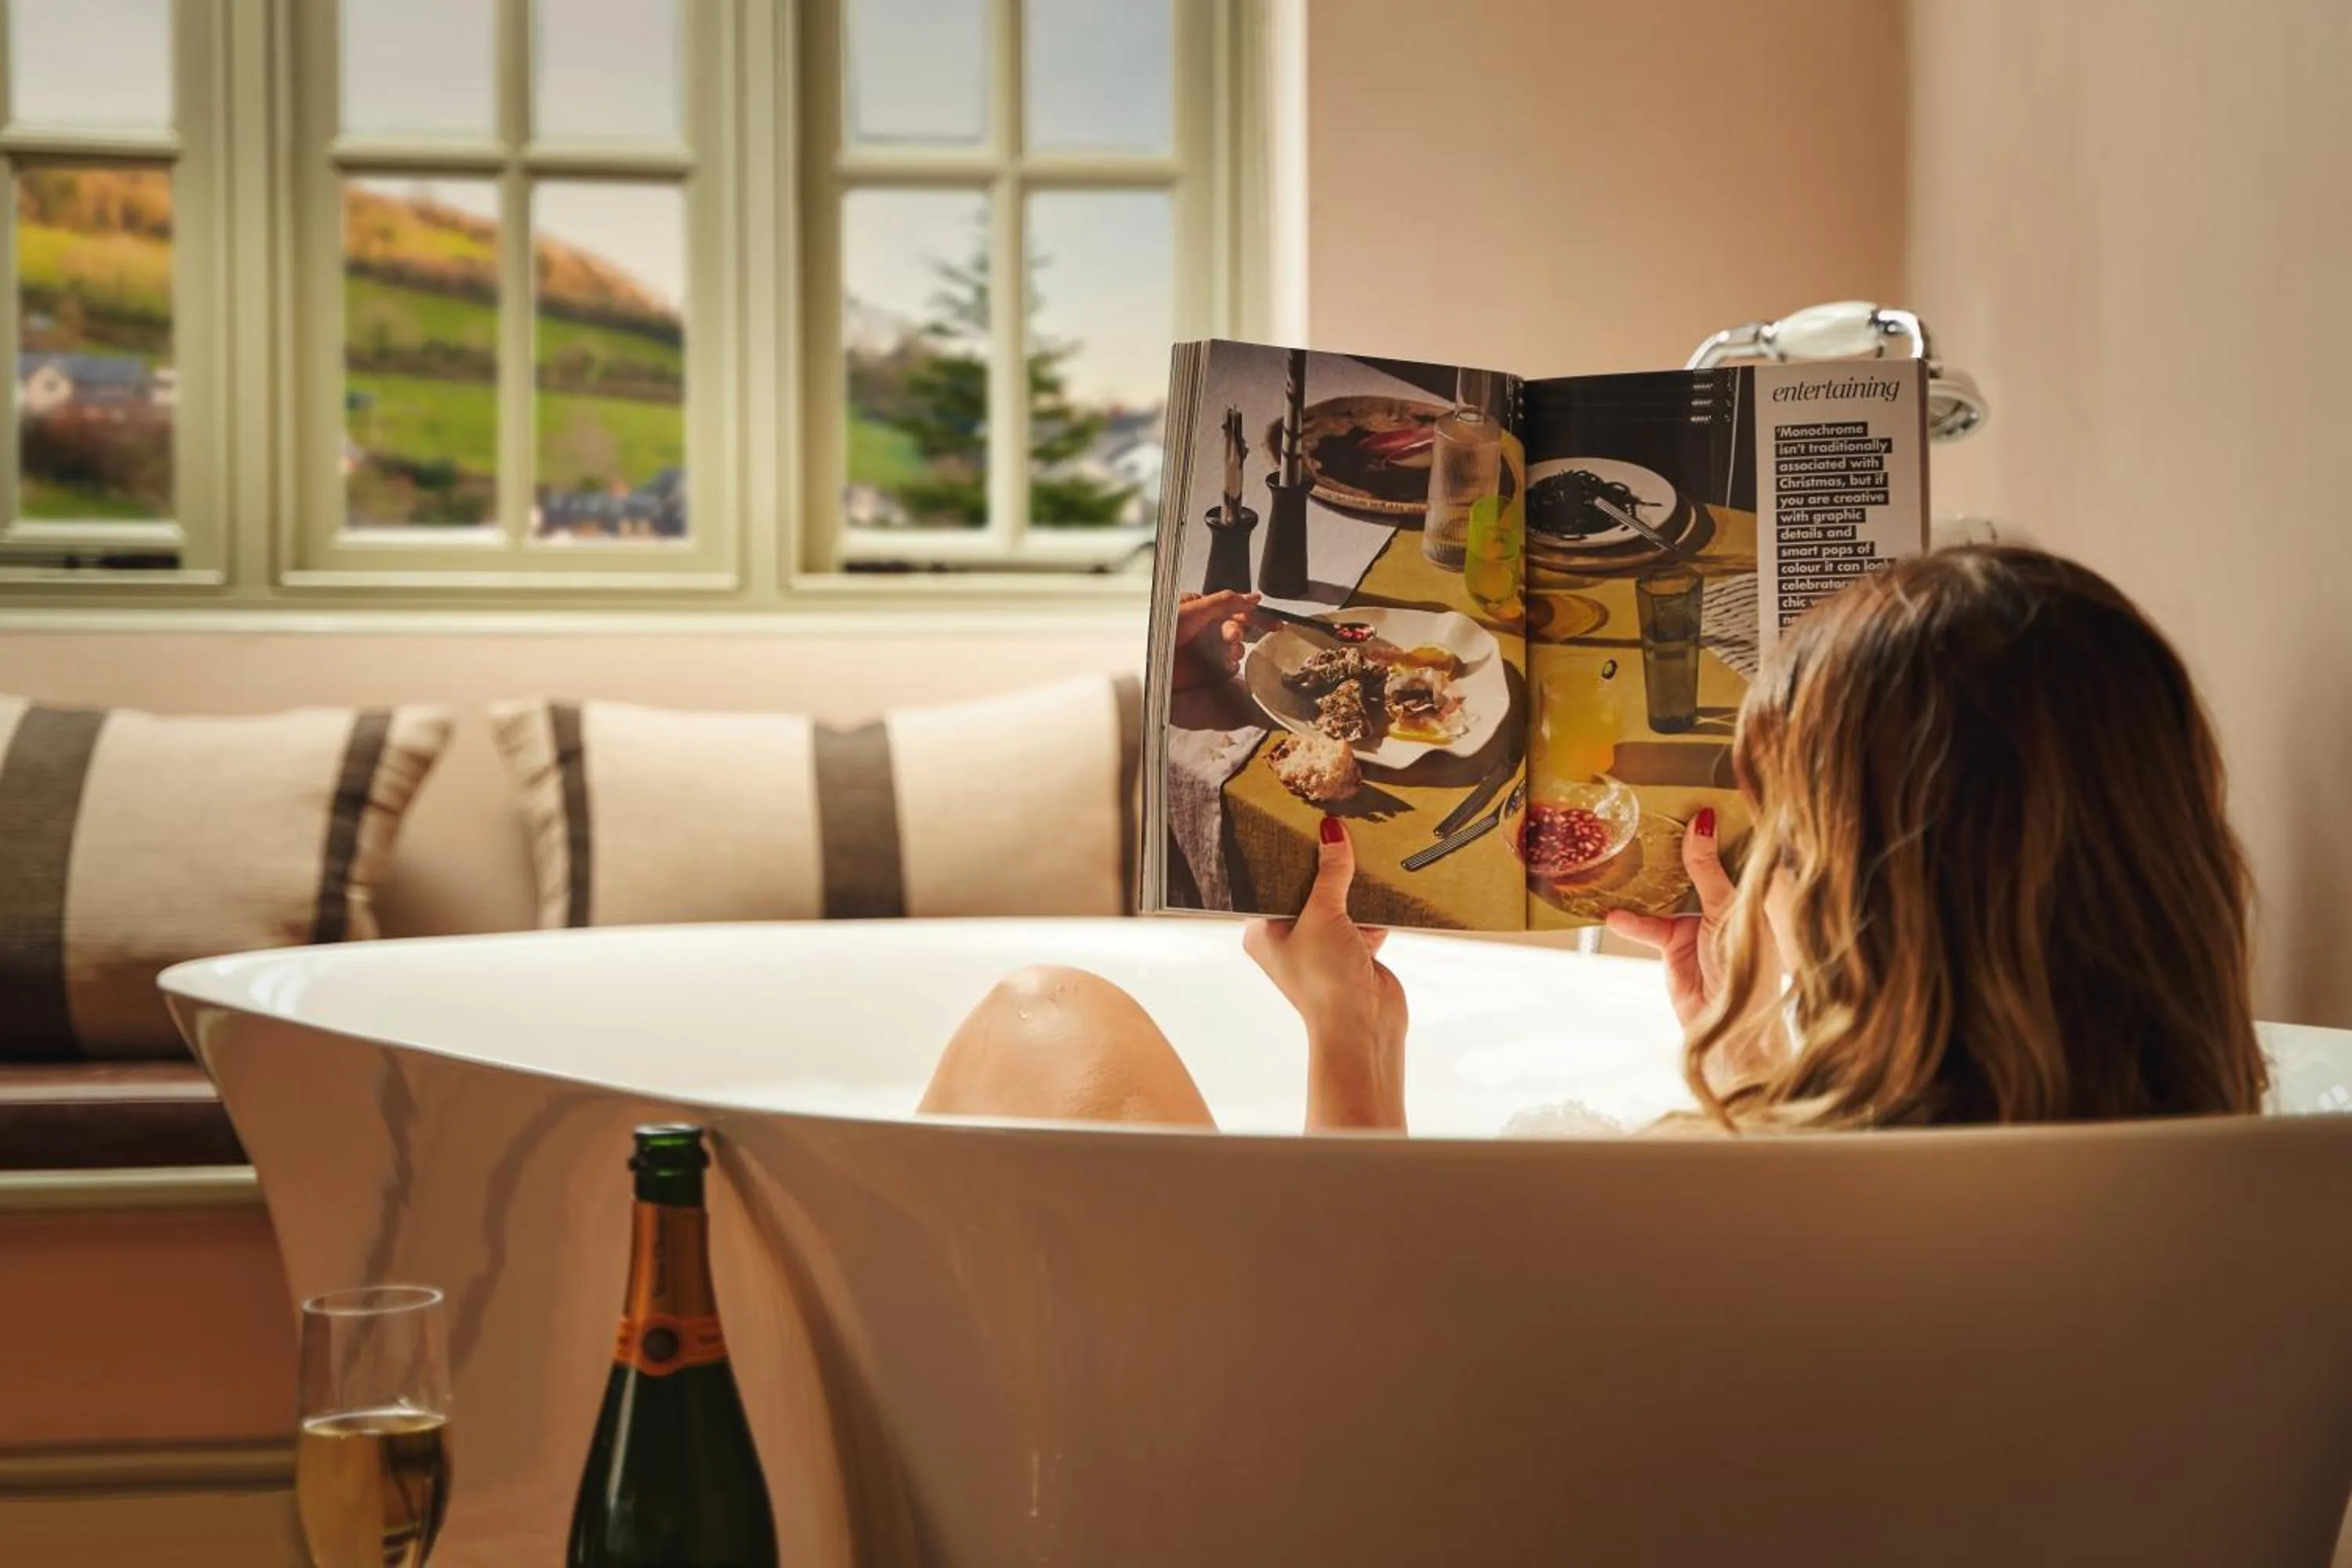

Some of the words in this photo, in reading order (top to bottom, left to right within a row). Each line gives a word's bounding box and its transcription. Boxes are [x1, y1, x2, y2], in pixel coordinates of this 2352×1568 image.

[1773, 376, 1900, 402] entertaining
[1779, 443, 1805, 456] isn't
[1809, 439, 1888, 453] traditionally
[1779, 457, 1846, 472] associated
[1851, 456, 1879, 468] with
[1780, 475, 1846, 489] Christmas,
[1850, 474, 1871, 485] but
[1875, 473, 1885, 485] if
[1780, 495, 1804, 508] you
[1808, 495, 1830, 505] are
[1833, 490, 1885, 503] creative
[1780, 511, 1809, 523] with
[1813, 509, 1862, 524] graphic
[1780, 528, 1823, 540] details
[1827, 526, 1853, 538] and
[1781, 545, 1818, 557] smart
[1822, 546, 1853, 558] pops
[1857, 543, 1871, 554] of
[1781, 562, 1821, 574] colour
[1824, 561, 1834, 572] it
[1837, 562, 1860, 572] can
[1782, 595, 1806, 608] chic
